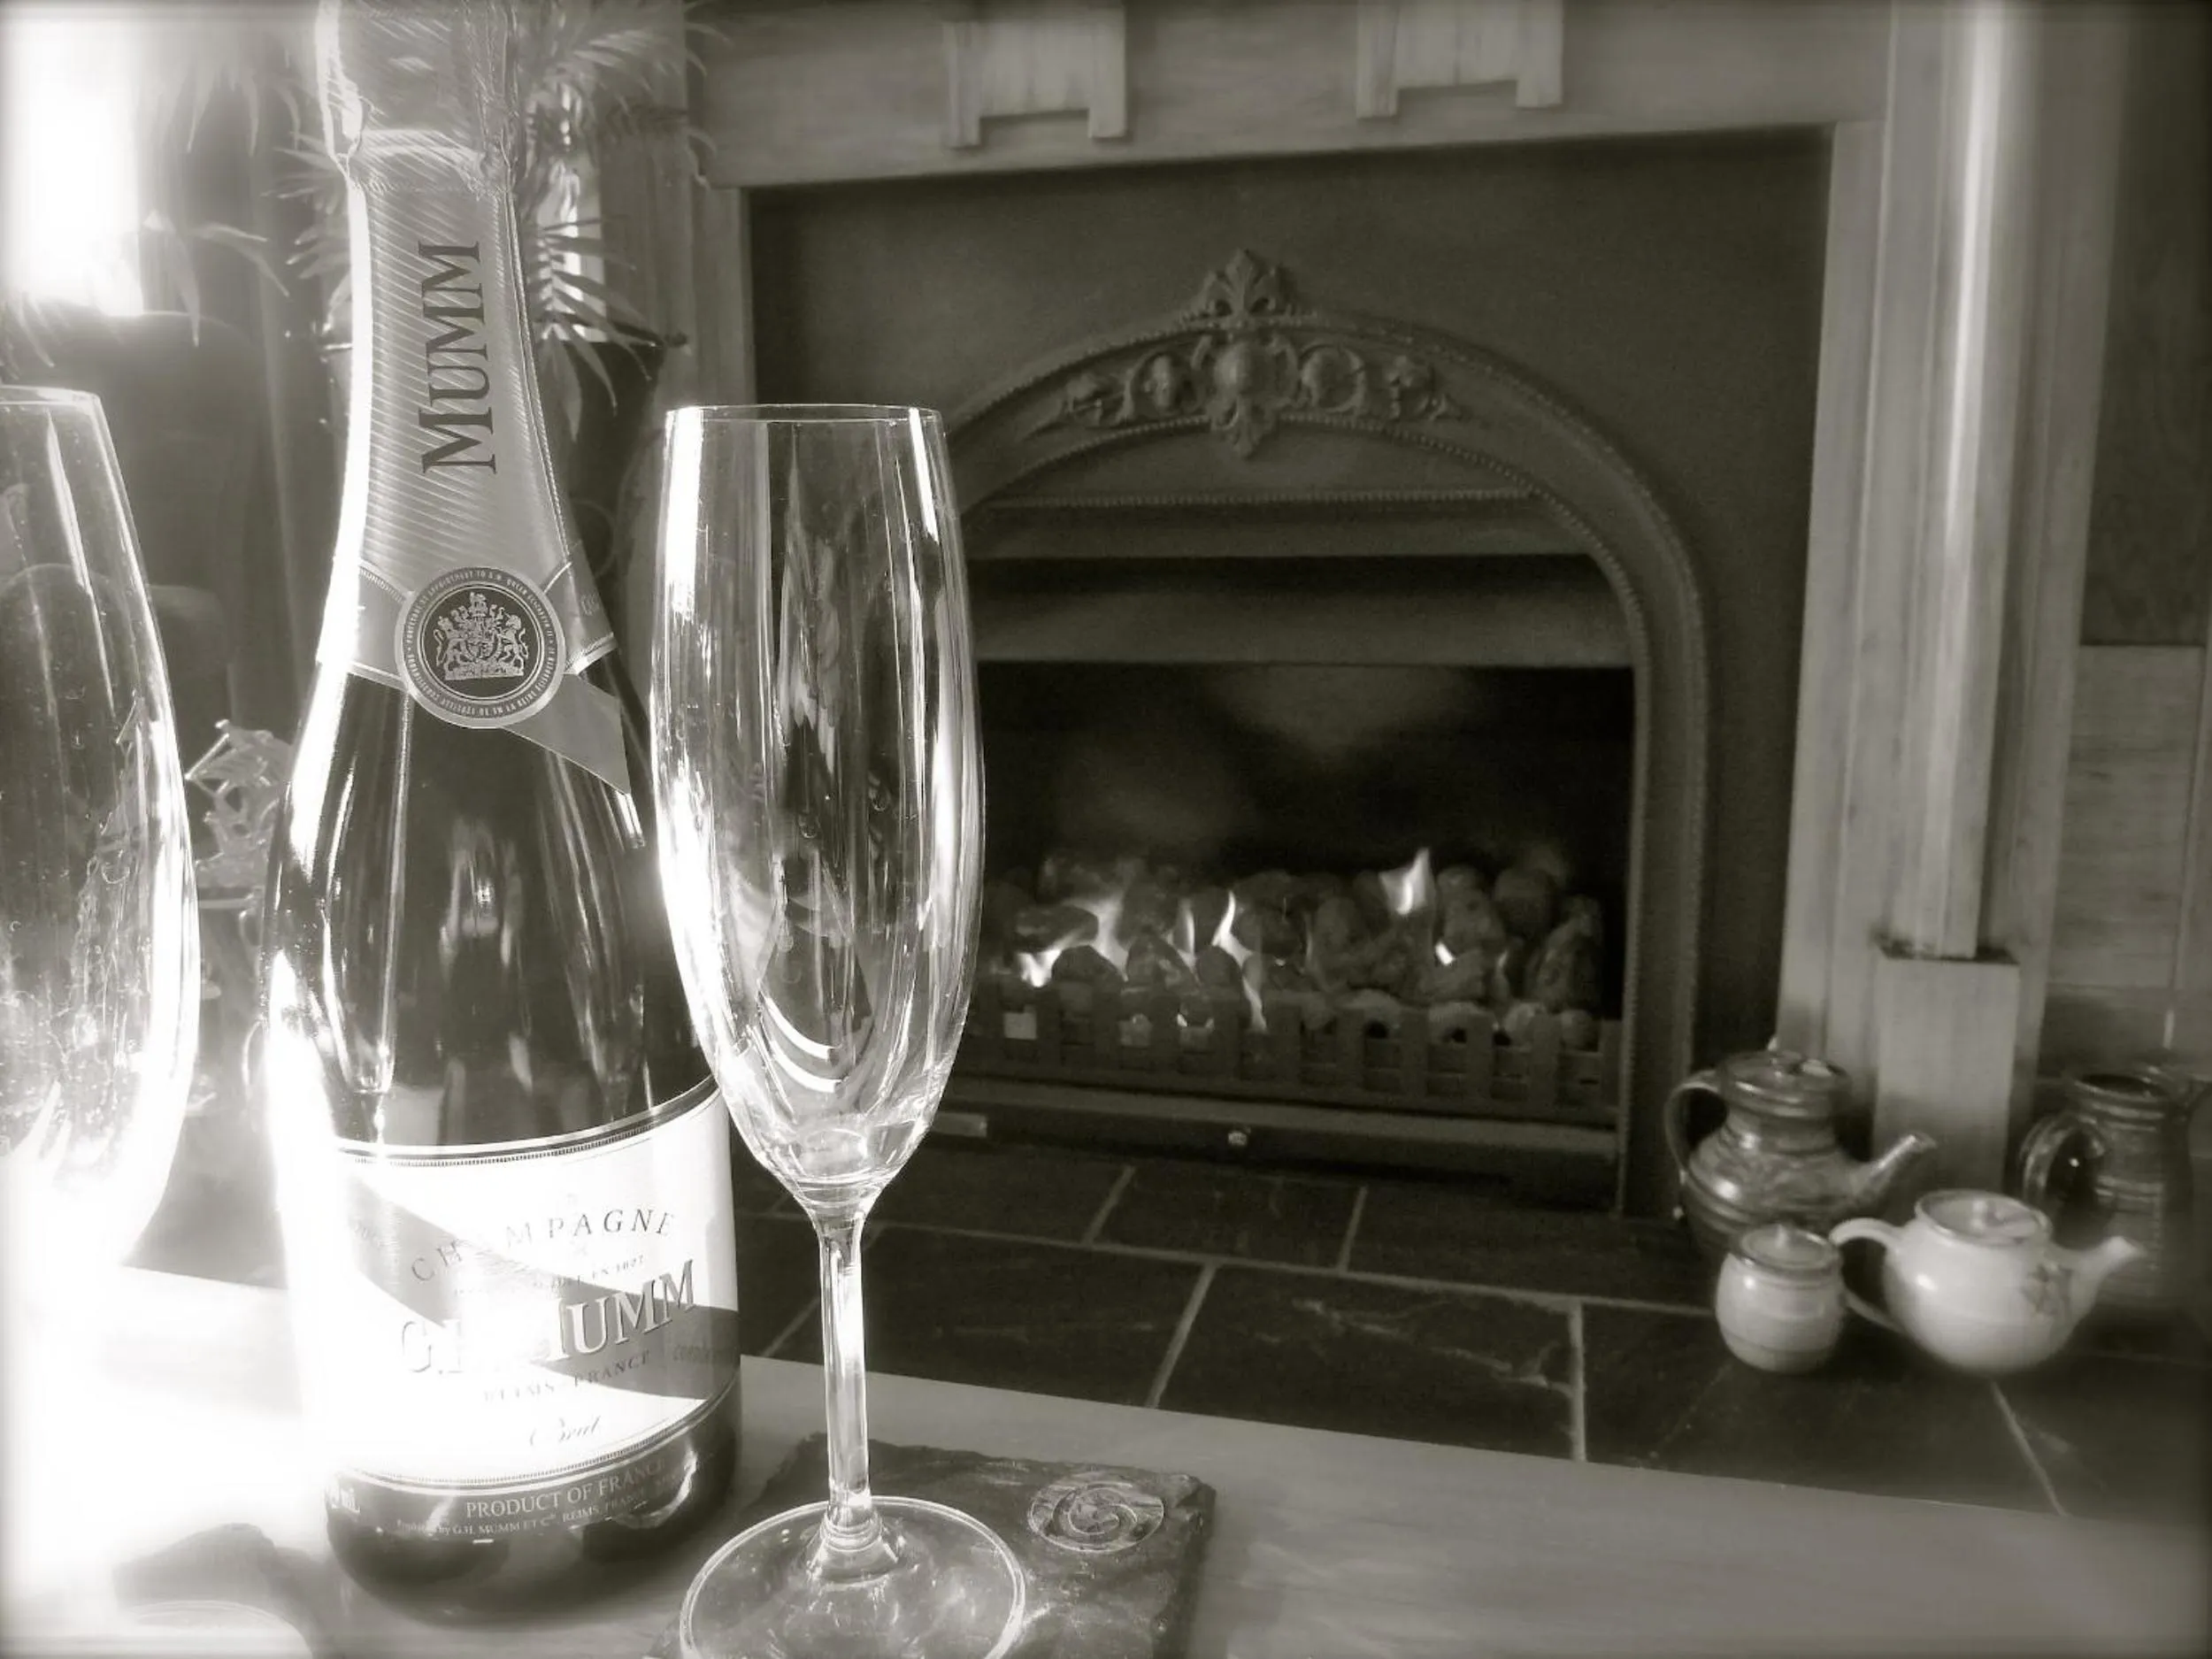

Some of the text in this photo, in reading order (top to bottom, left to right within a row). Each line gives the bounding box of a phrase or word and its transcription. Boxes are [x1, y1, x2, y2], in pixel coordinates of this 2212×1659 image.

[418, 240, 496, 473] MUMM
[410, 1208, 675, 1283] CHMPAGNE
[466, 1491, 562, 1518] PRODUCT
[567, 1483, 593, 1503] OF
[478, 1521, 519, 1534] MUMM
